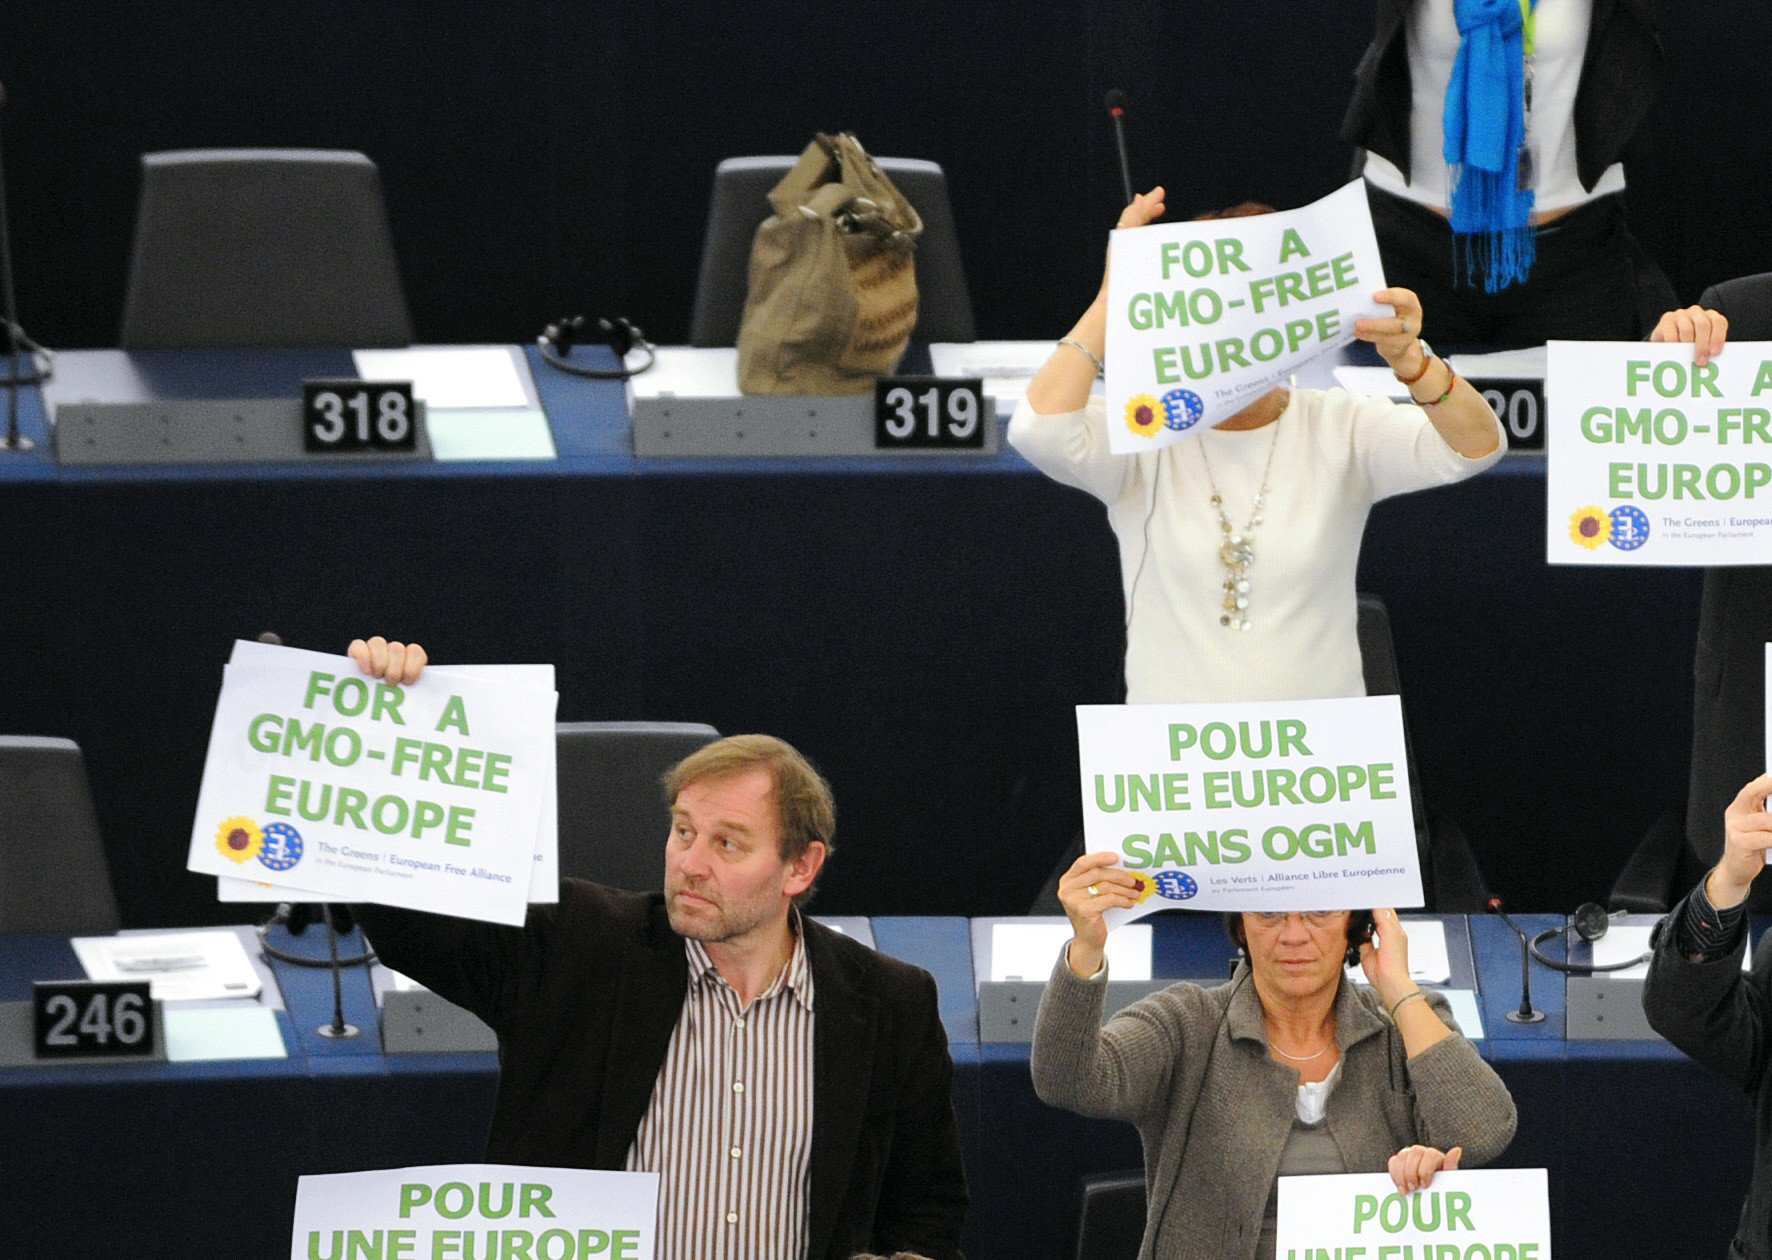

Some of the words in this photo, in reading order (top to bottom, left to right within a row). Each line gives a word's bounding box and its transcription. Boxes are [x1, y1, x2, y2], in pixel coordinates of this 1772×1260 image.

[1162, 239, 1249, 278] FOR
[1280, 230, 1309, 263] A
[1129, 254, 1358, 331] GMO-FREE
[1154, 311, 1338, 385] EUROPE
[1627, 362, 1721, 398] FOR
[314, 392, 409, 442] 318
[886, 388, 978, 438] 319
[1663, 517, 1680, 527] The
[1684, 518, 1719, 527] Greens
[305, 672, 405, 724] FOR
[437, 696, 469, 735] A
[249, 715, 511, 793] GMO-FREE
[1169, 720, 1310, 761] POUR
[266, 776, 475, 846] EUROPE
[1096, 774, 1191, 813] UNE
[1204, 764, 1396, 809] EUROPE
[1123, 829, 1251, 868] SANS
[1263, 821, 1376, 861] OGM
[1210, 877, 1227, 885] Les
[1231, 875, 1257, 884] Verts
[1268, 872, 1309, 882] Alliance
[1313, 870, 1339, 879] Libre
[1343, 866, 1406, 879] Européenne
[46, 992, 144, 1045] 246
[400, 1182, 553, 1219] POUR
[1354, 1191, 1474, 1233] POUR
